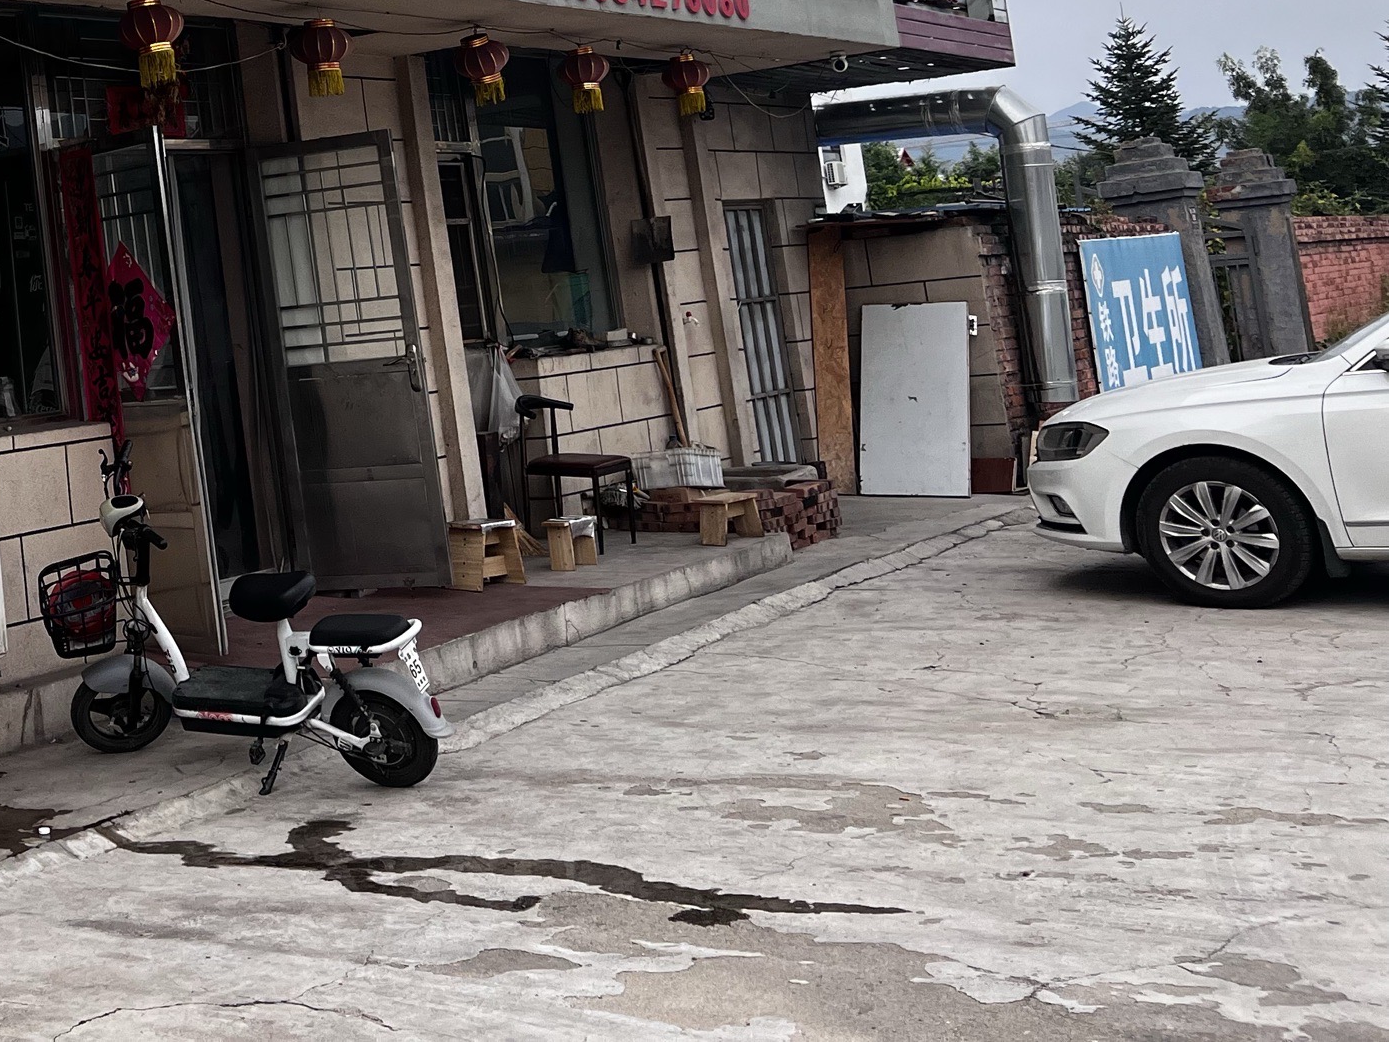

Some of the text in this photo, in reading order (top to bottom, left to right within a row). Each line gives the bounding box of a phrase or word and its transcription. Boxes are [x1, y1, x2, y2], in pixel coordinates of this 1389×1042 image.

[108, 277, 154, 359] 福
[1111, 265, 1197, 388] 卫生所
